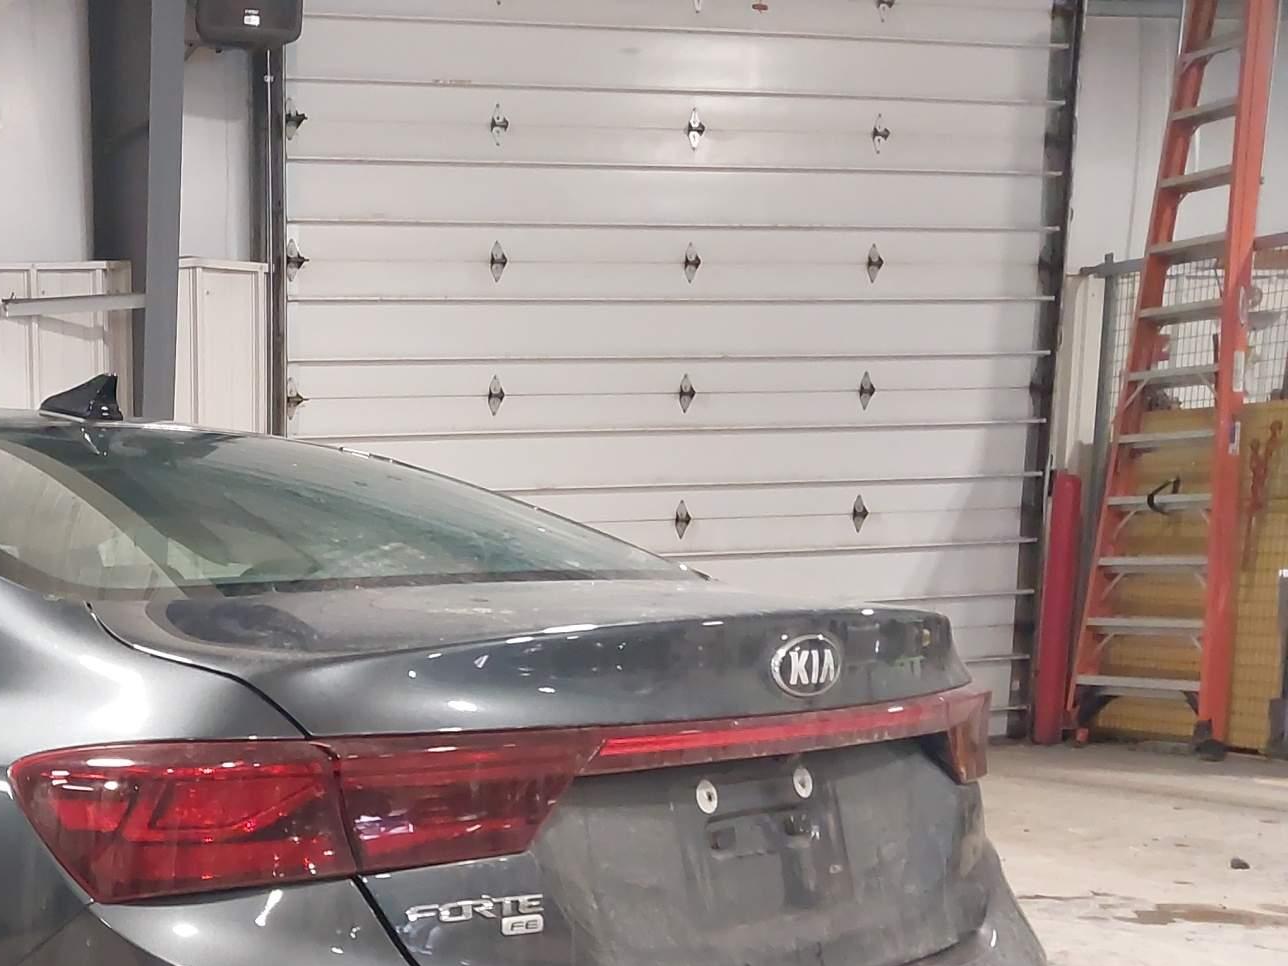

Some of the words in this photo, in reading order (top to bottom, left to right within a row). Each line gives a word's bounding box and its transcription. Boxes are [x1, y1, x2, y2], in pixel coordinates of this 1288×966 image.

[789, 649, 835, 685] KIA
[405, 893, 544, 922] FORTE
[510, 919, 539, 932] FE
